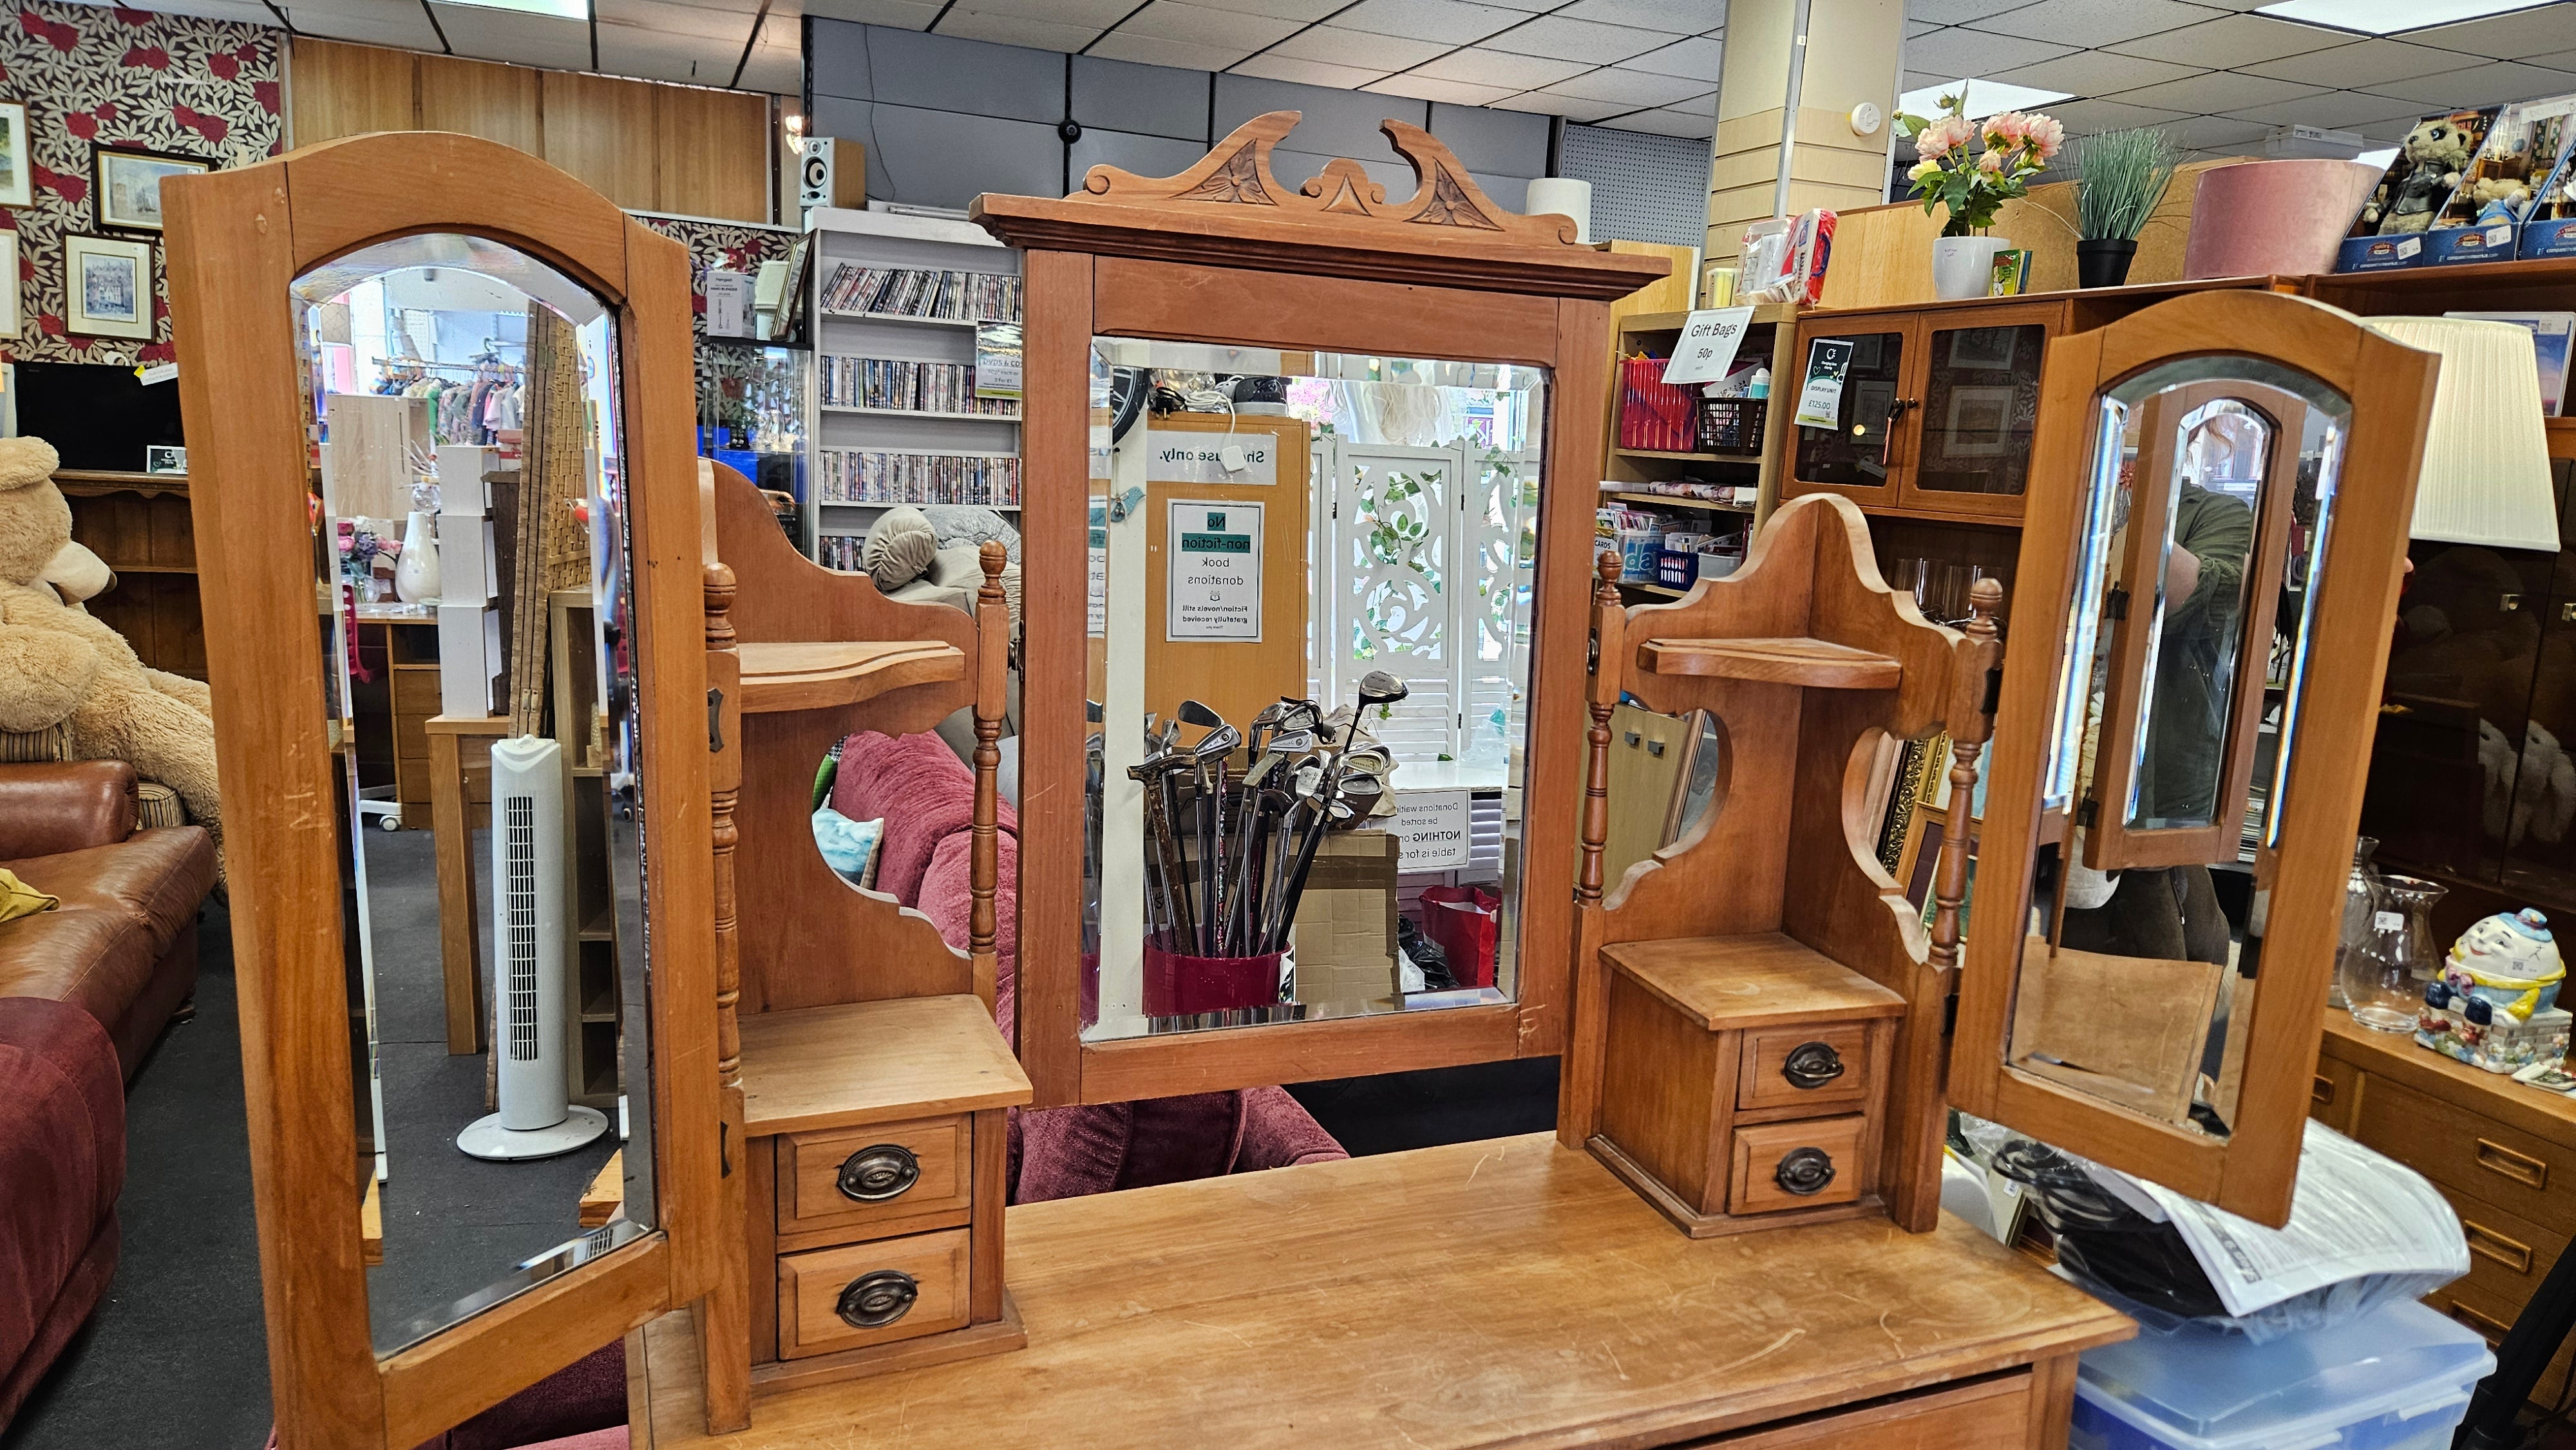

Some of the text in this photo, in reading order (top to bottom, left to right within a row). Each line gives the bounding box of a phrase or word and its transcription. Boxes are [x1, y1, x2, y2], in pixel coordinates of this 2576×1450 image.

[1691, 323, 1738, 338] Gift Bags
[1697, 348, 1713, 361] 50p
[1808, 400, 1831, 410] £125.00
